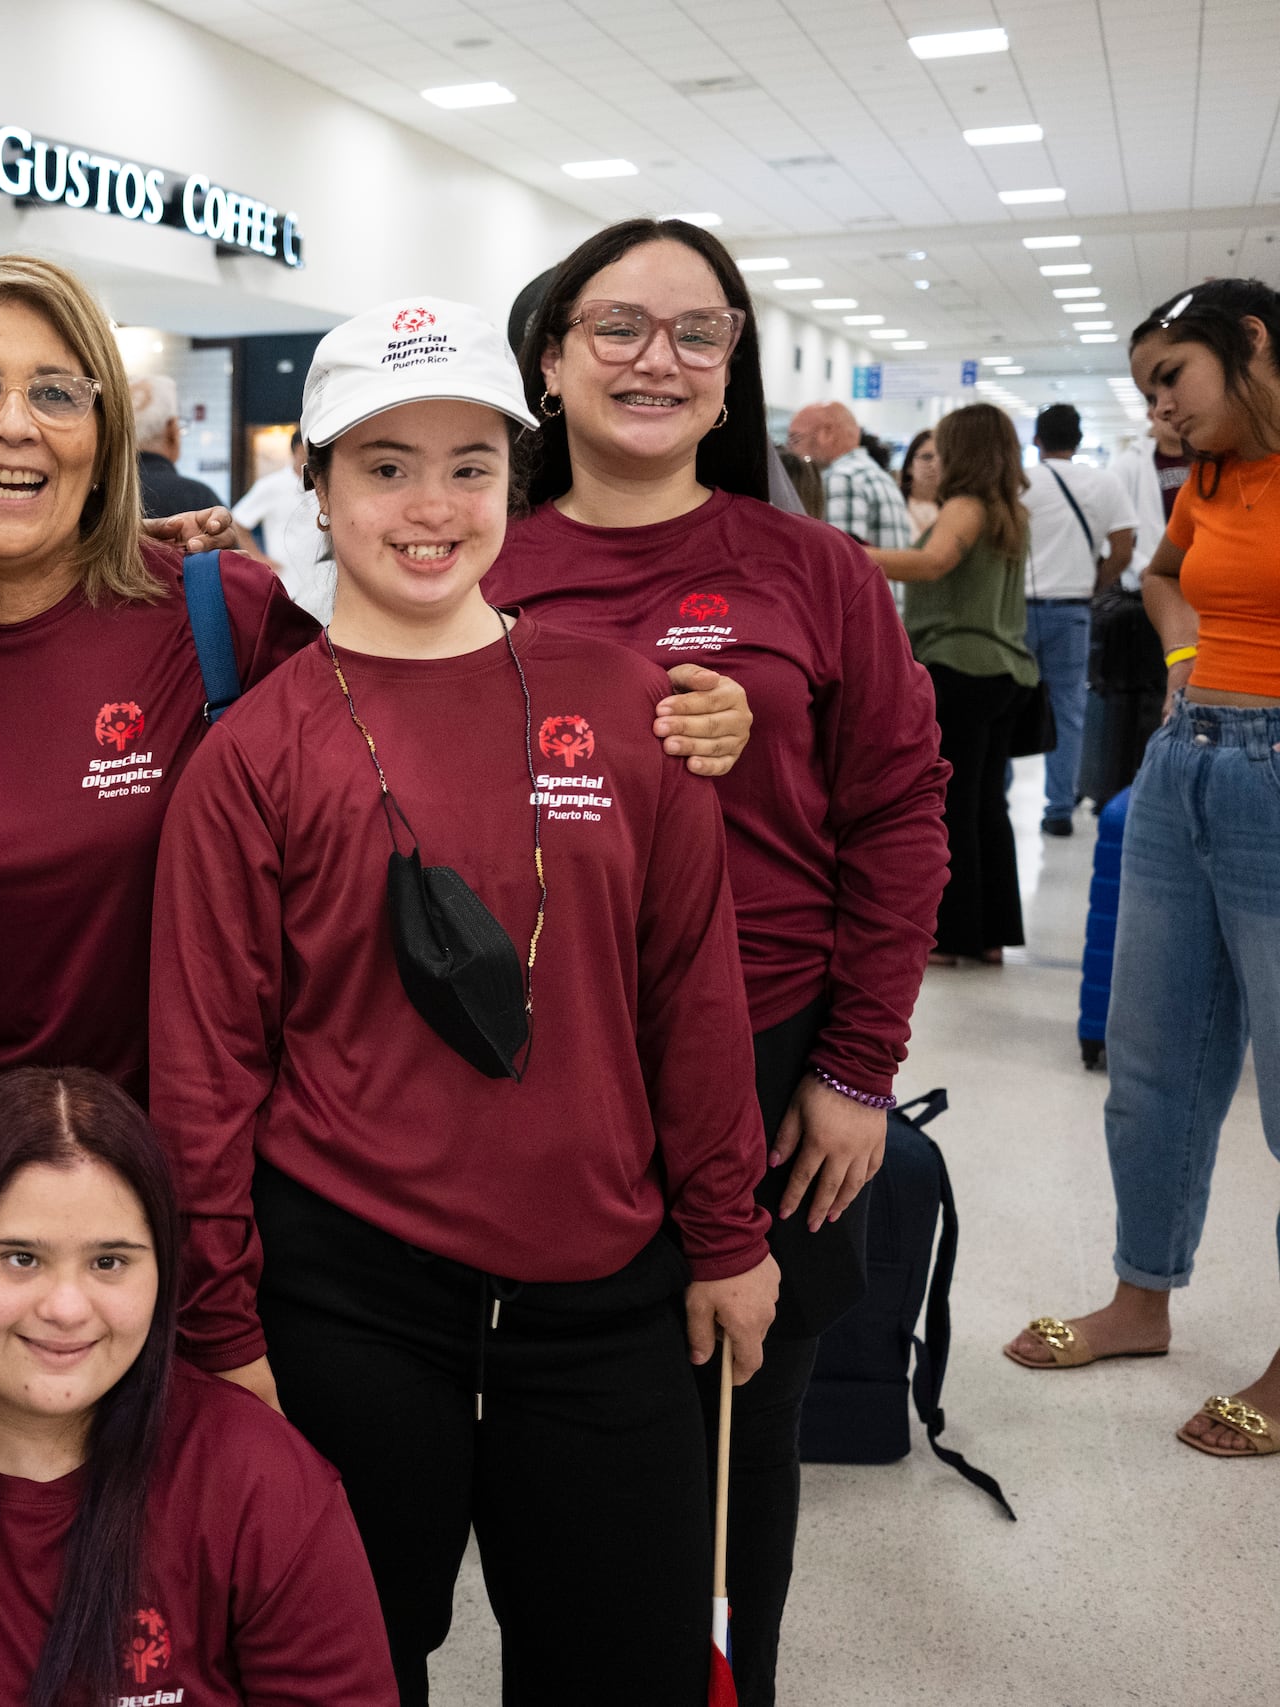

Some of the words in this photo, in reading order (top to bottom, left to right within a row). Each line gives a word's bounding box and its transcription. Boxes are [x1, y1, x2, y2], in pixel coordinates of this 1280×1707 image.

[182, 173, 278, 257] COFFEE
[387, 333, 448, 351] Special
[392, 358, 426, 372] Puerto
[427, 355, 449, 364] Rico
[665, 624, 733, 636] Special
[700, 643, 722, 651] Rico
[88, 751, 153, 773] Special
[81, 767, 163, 788] Olympics
[536, 774, 604, 790] Special
[97, 787, 130, 799] Puerto
[130, 784, 151, 795] Rico
[529, 792, 613, 808] Olympics
[547, 810, 582, 820] Puerto
[582, 811, 601, 822] Rico
[116, 1687, 185, 1707] pecial
